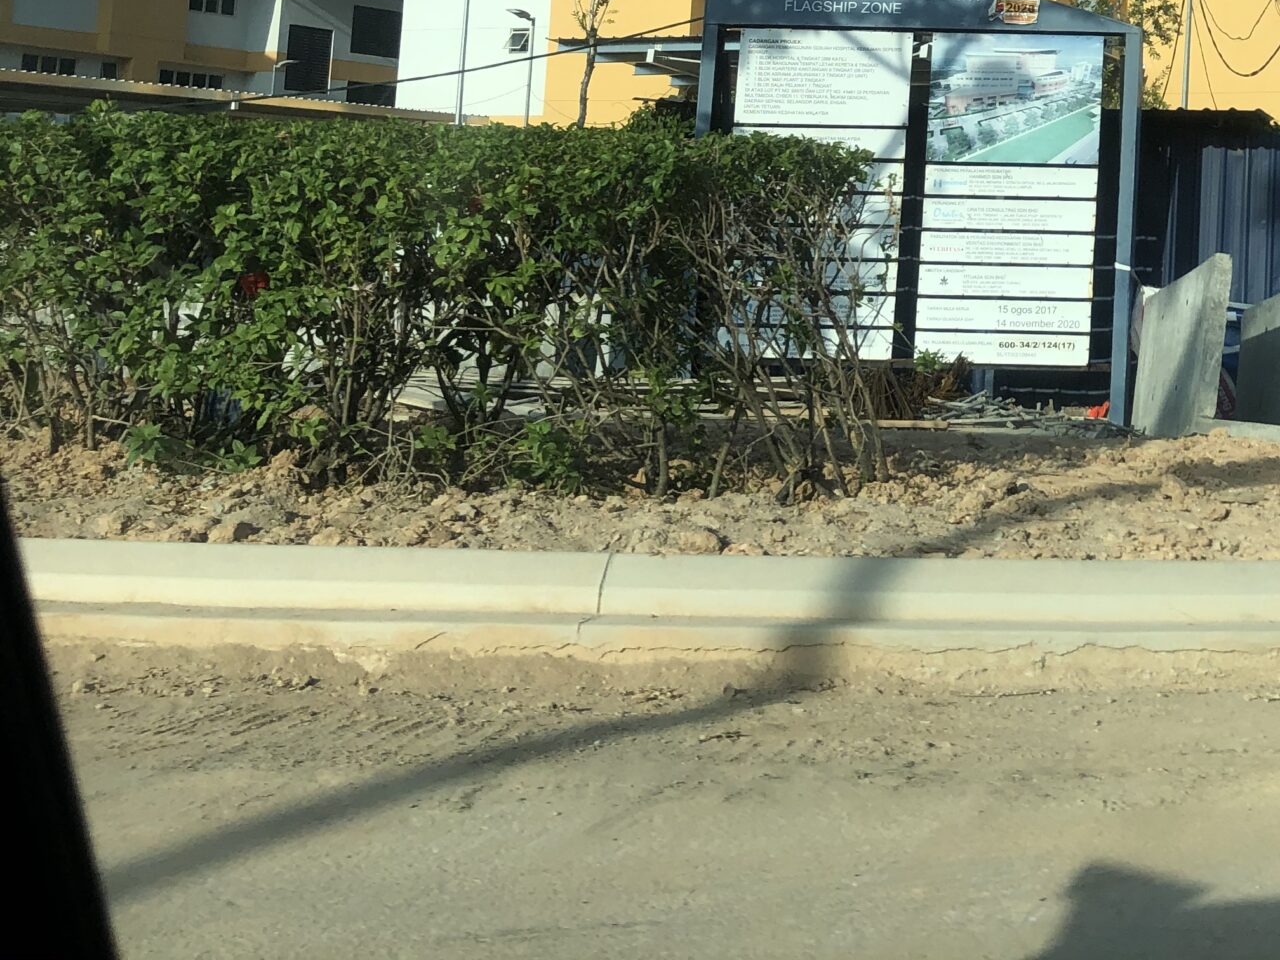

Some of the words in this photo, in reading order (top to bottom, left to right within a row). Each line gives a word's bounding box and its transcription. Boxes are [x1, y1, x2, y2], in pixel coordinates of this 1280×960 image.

[784, 0, 858, 13] FLAGSHIP
[861, 1, 903, 14] ZONE
[997, 304, 1008, 314] 15
[1011, 306, 1033, 316] ogos
[1035, 305, 1057, 315] 2017
[996, 319, 1007, 328] 14
[1009, 319, 1055, 328] november
[1057, 319, 1081, 329] 2020
